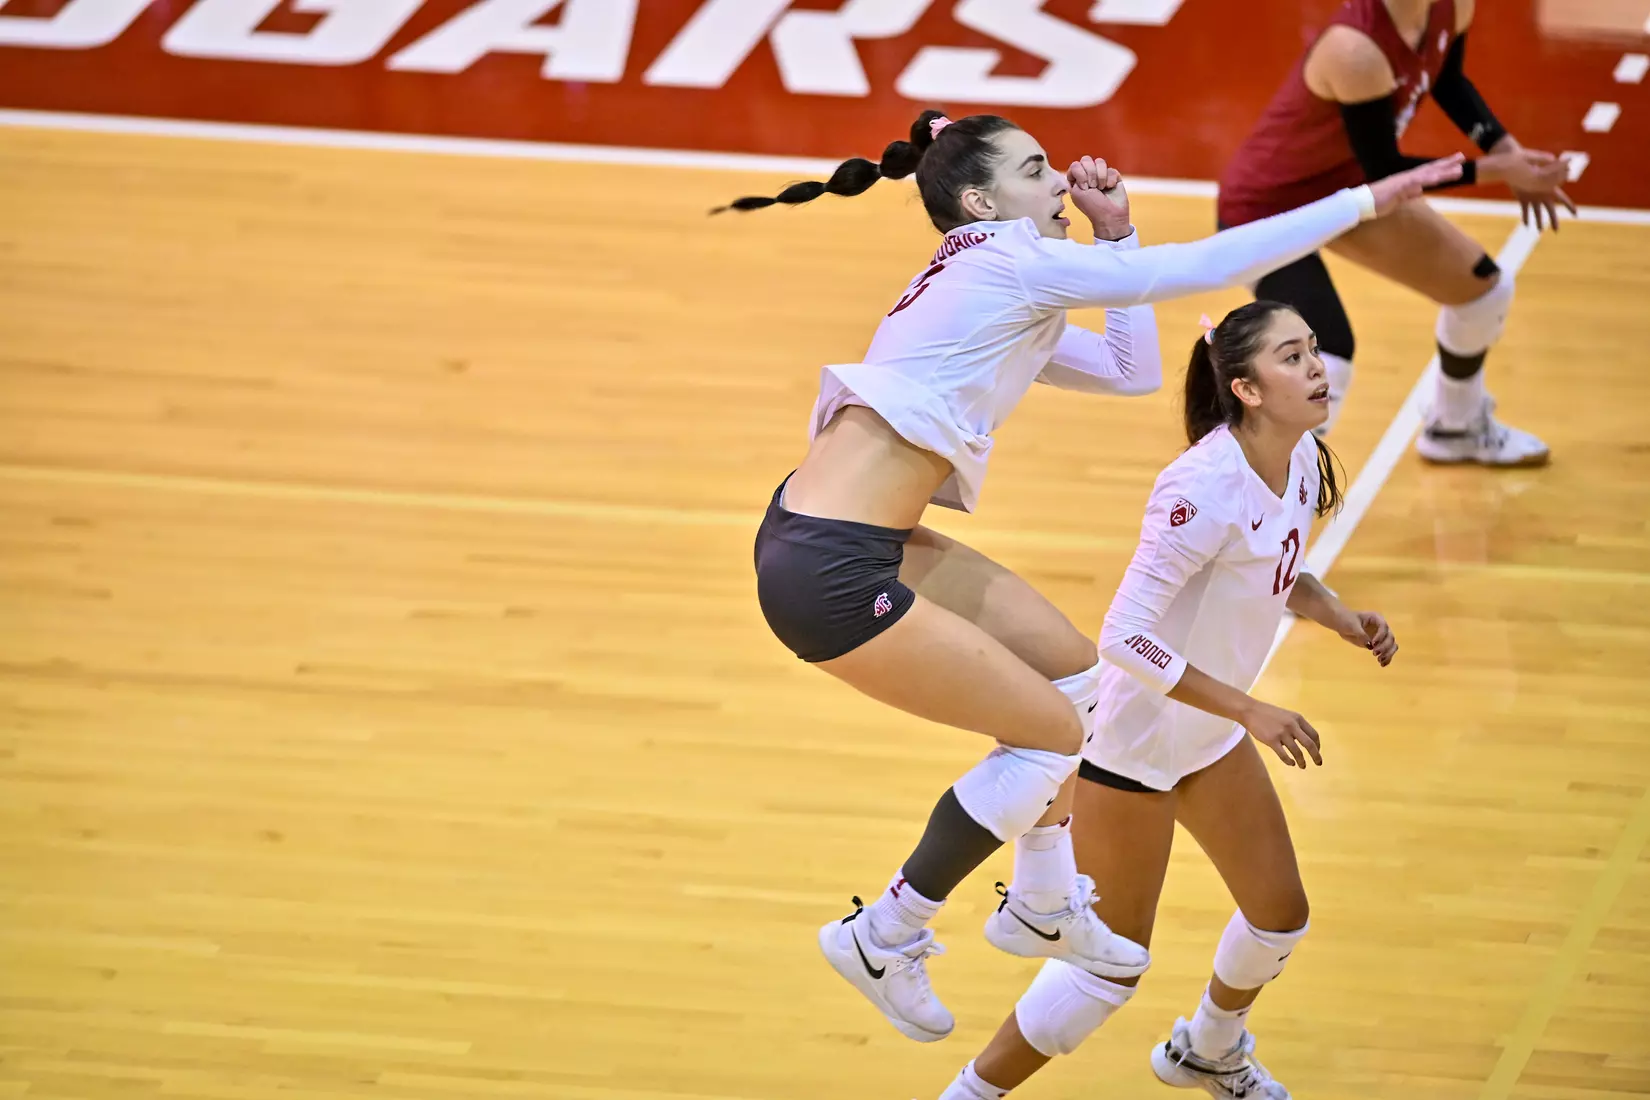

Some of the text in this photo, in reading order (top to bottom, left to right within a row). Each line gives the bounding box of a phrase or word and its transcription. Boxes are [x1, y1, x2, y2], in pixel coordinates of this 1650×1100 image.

[1171, 497, 1197, 522] PAC
[1171, 512, 1184, 525] 12
[1272, 527, 1300, 596] 12
